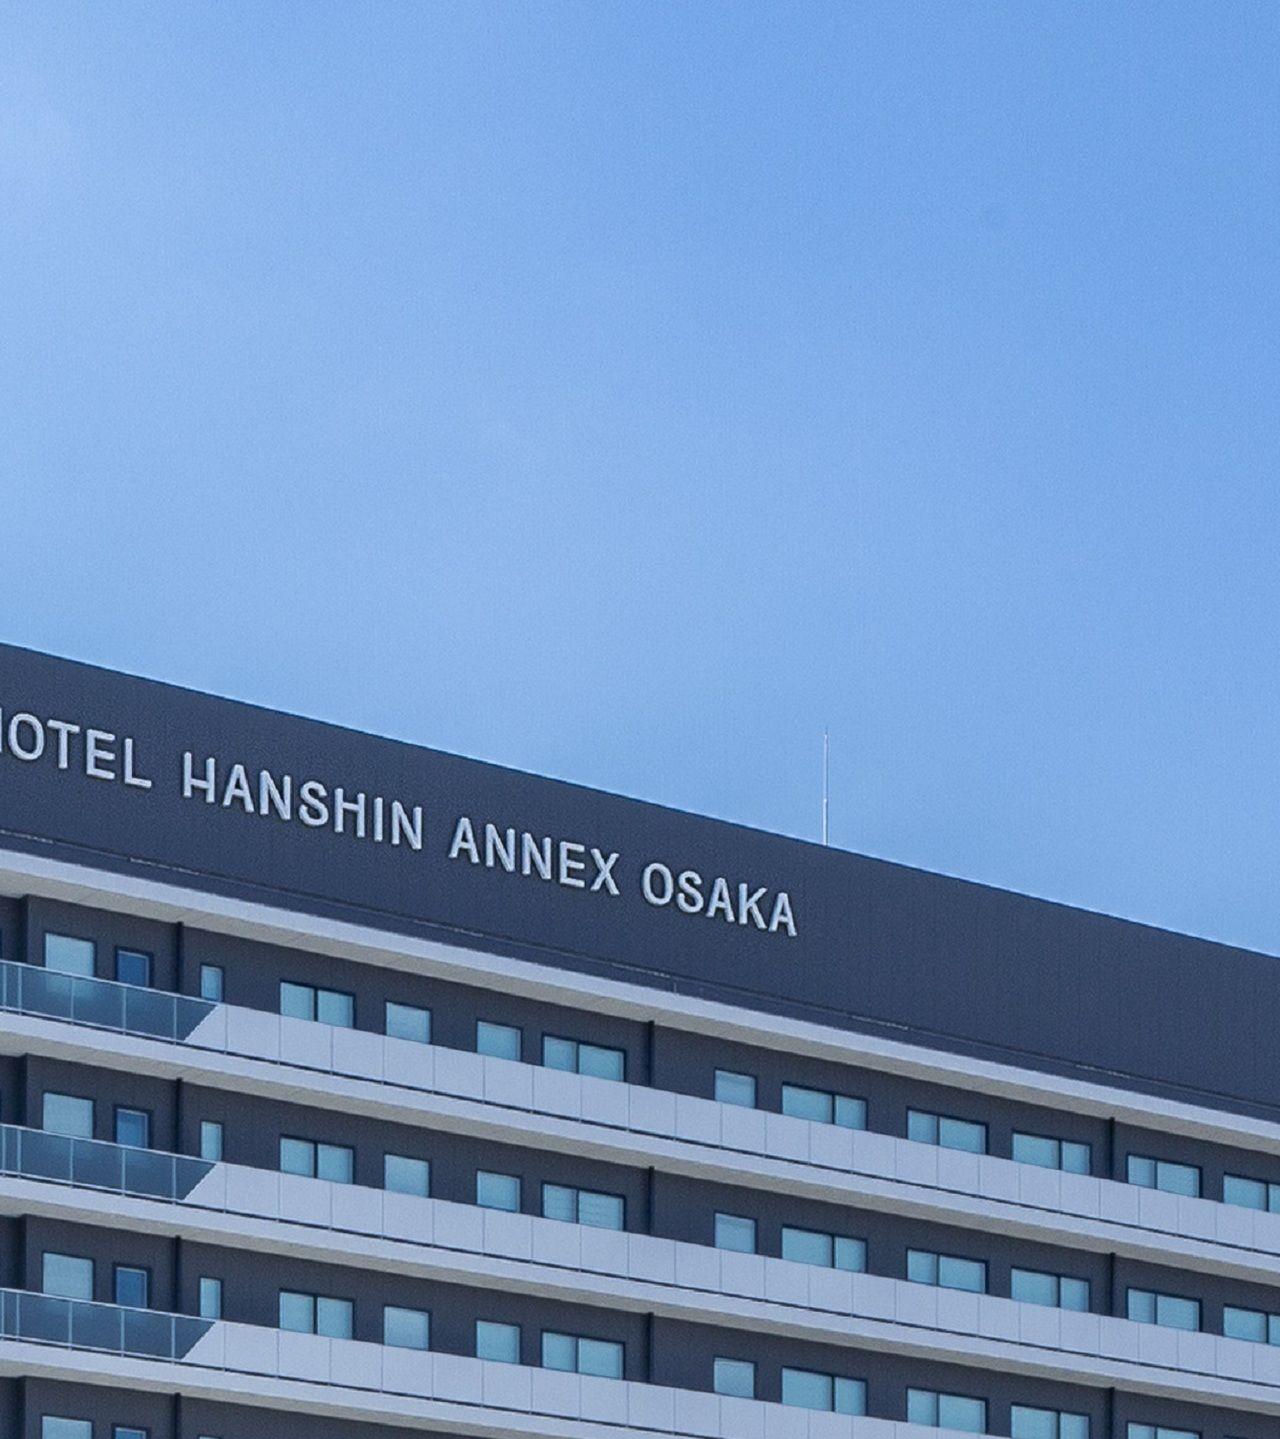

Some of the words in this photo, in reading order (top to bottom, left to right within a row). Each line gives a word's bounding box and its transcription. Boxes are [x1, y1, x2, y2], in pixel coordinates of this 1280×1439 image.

[183, 751, 423, 850] HANSHIN
[448, 816, 620, 895] ANNEX
[643, 862, 798, 937] OSAKA
